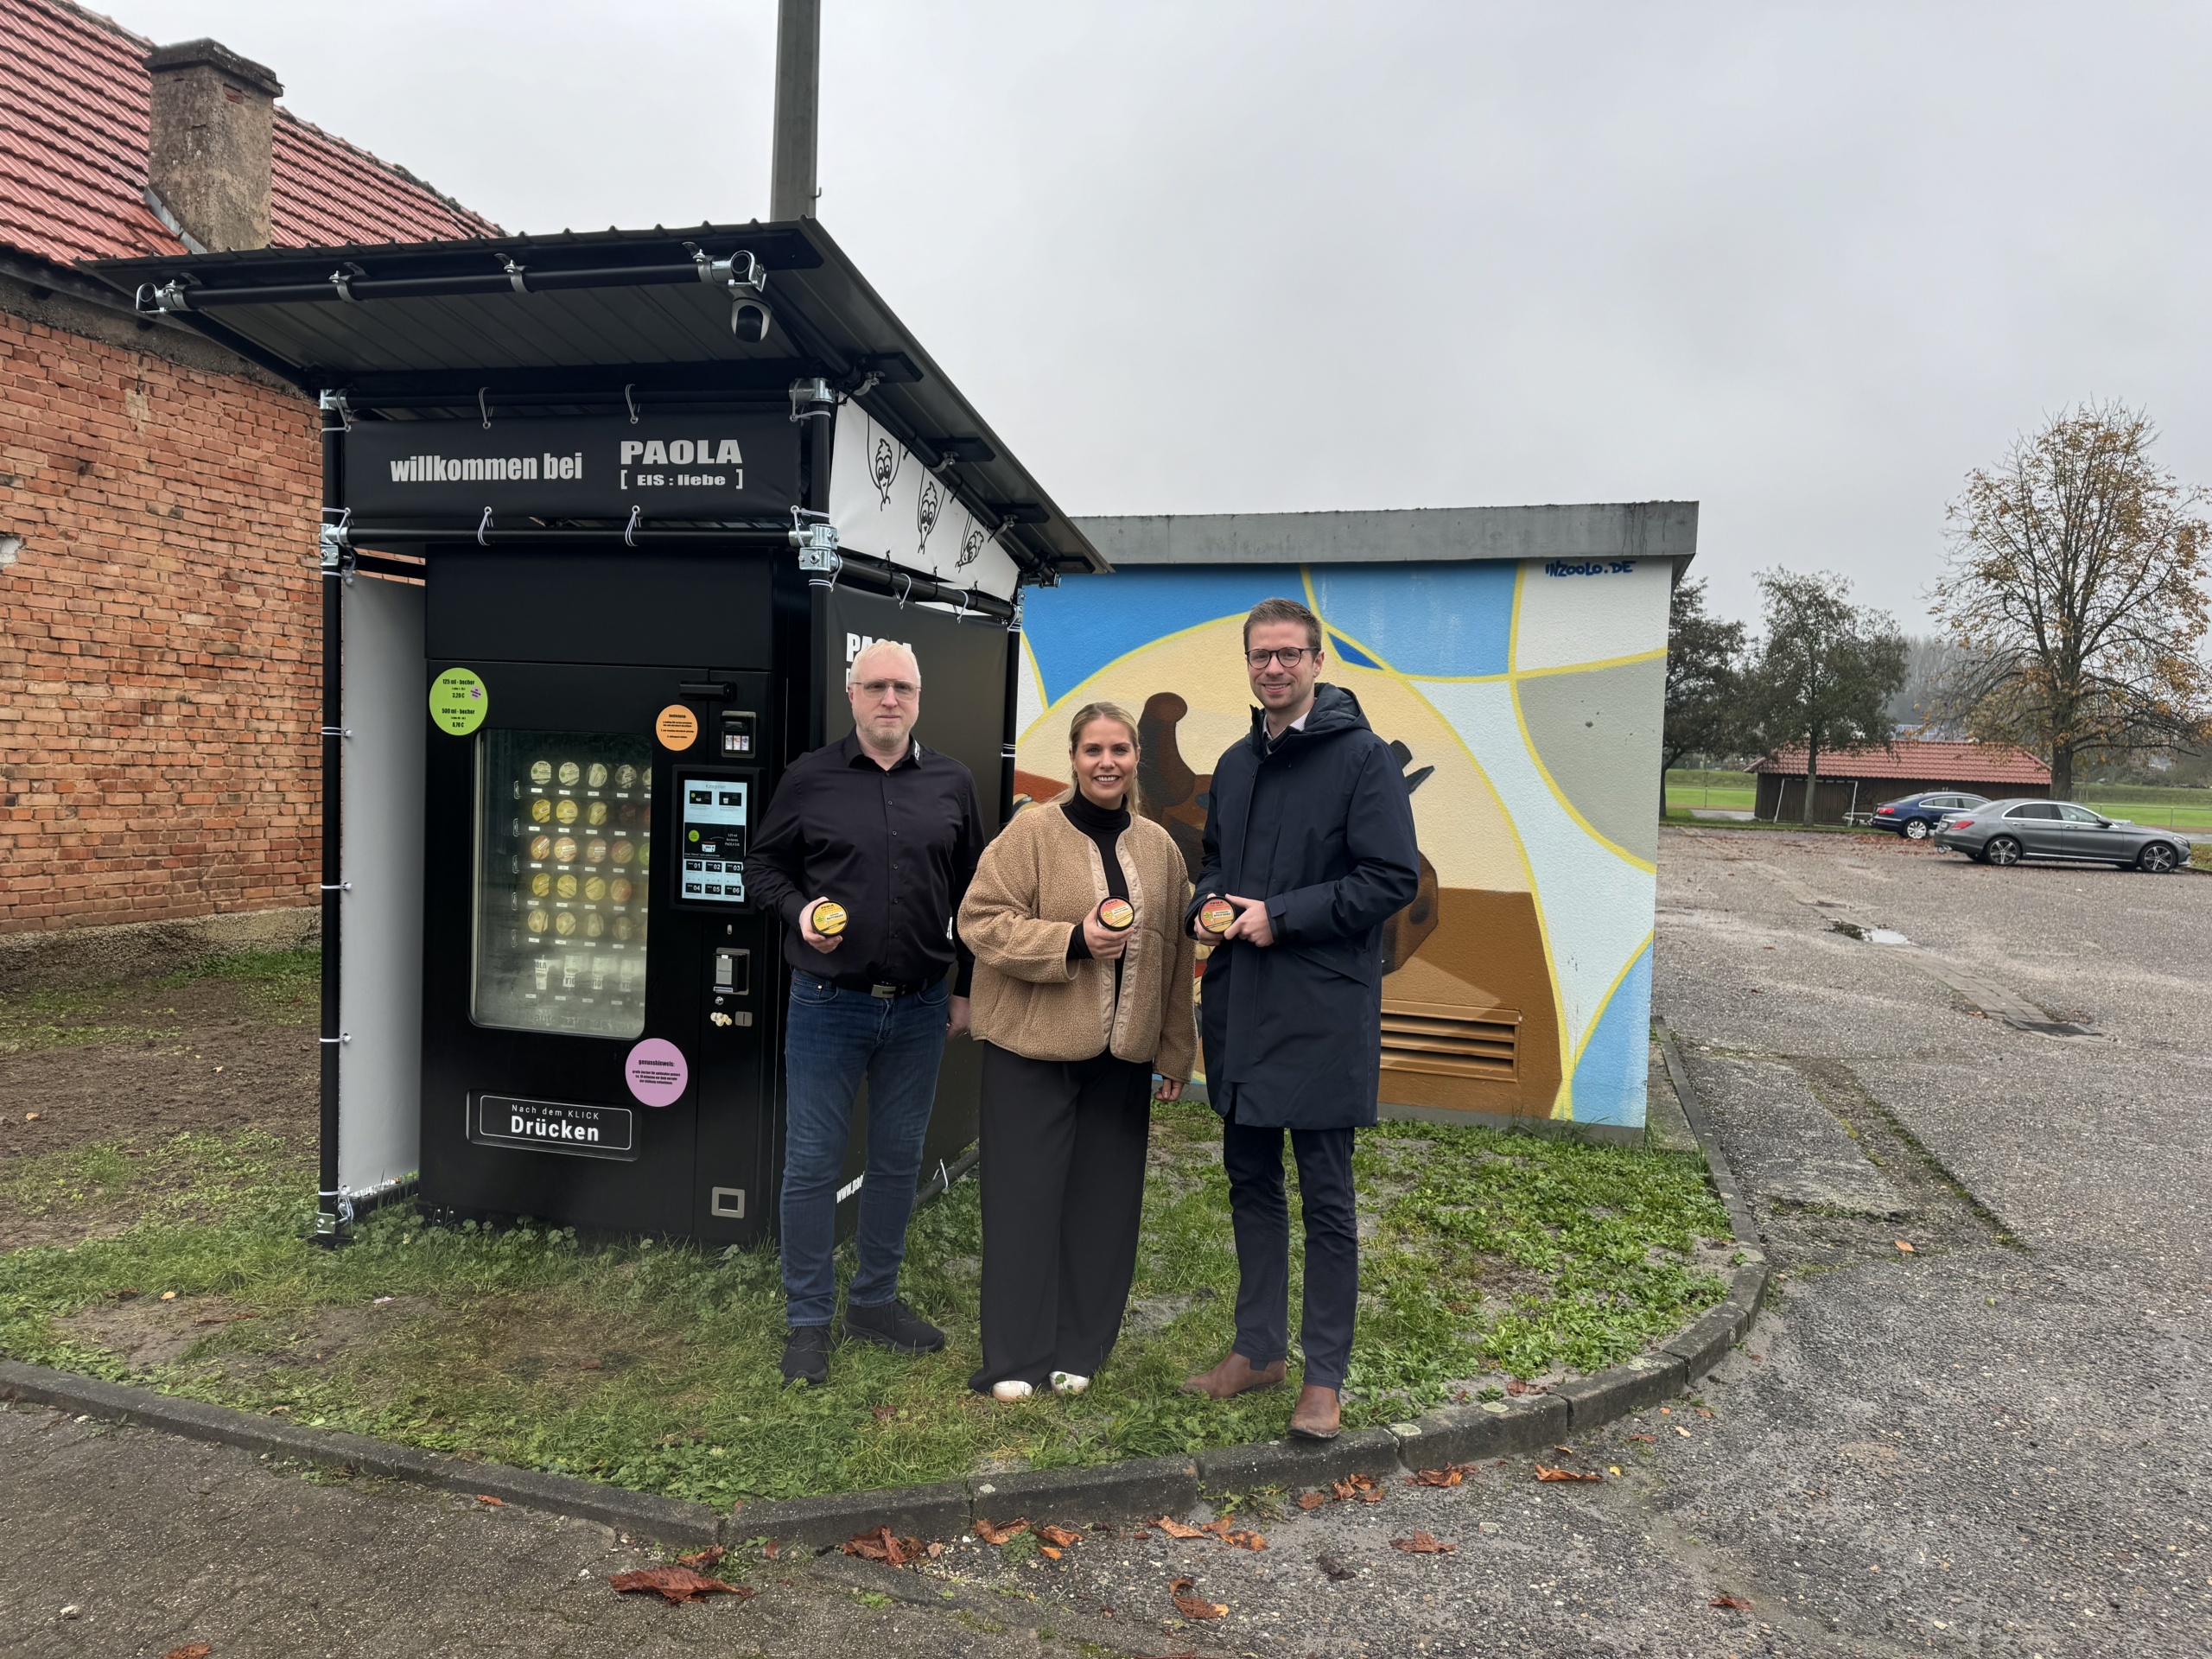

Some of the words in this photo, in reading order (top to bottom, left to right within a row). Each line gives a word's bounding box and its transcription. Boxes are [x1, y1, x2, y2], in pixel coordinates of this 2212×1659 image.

[620, 439, 743, 465] PAOLA
[391, 455, 537, 482] willkommen
[543, 452, 582, 480] bei
[637, 474, 664, 486] EIS
[677, 474, 726, 486] liebe
[1545, 560, 1637, 577] INZOOLO.DE
[512, 1104, 537, 1114] Nach
[542, 1107, 563, 1116] dem
[568, 1109, 599, 1120] KLICK
[511, 1115, 599, 1141] Drücken
[836, 1170, 865, 1205] www.pao
